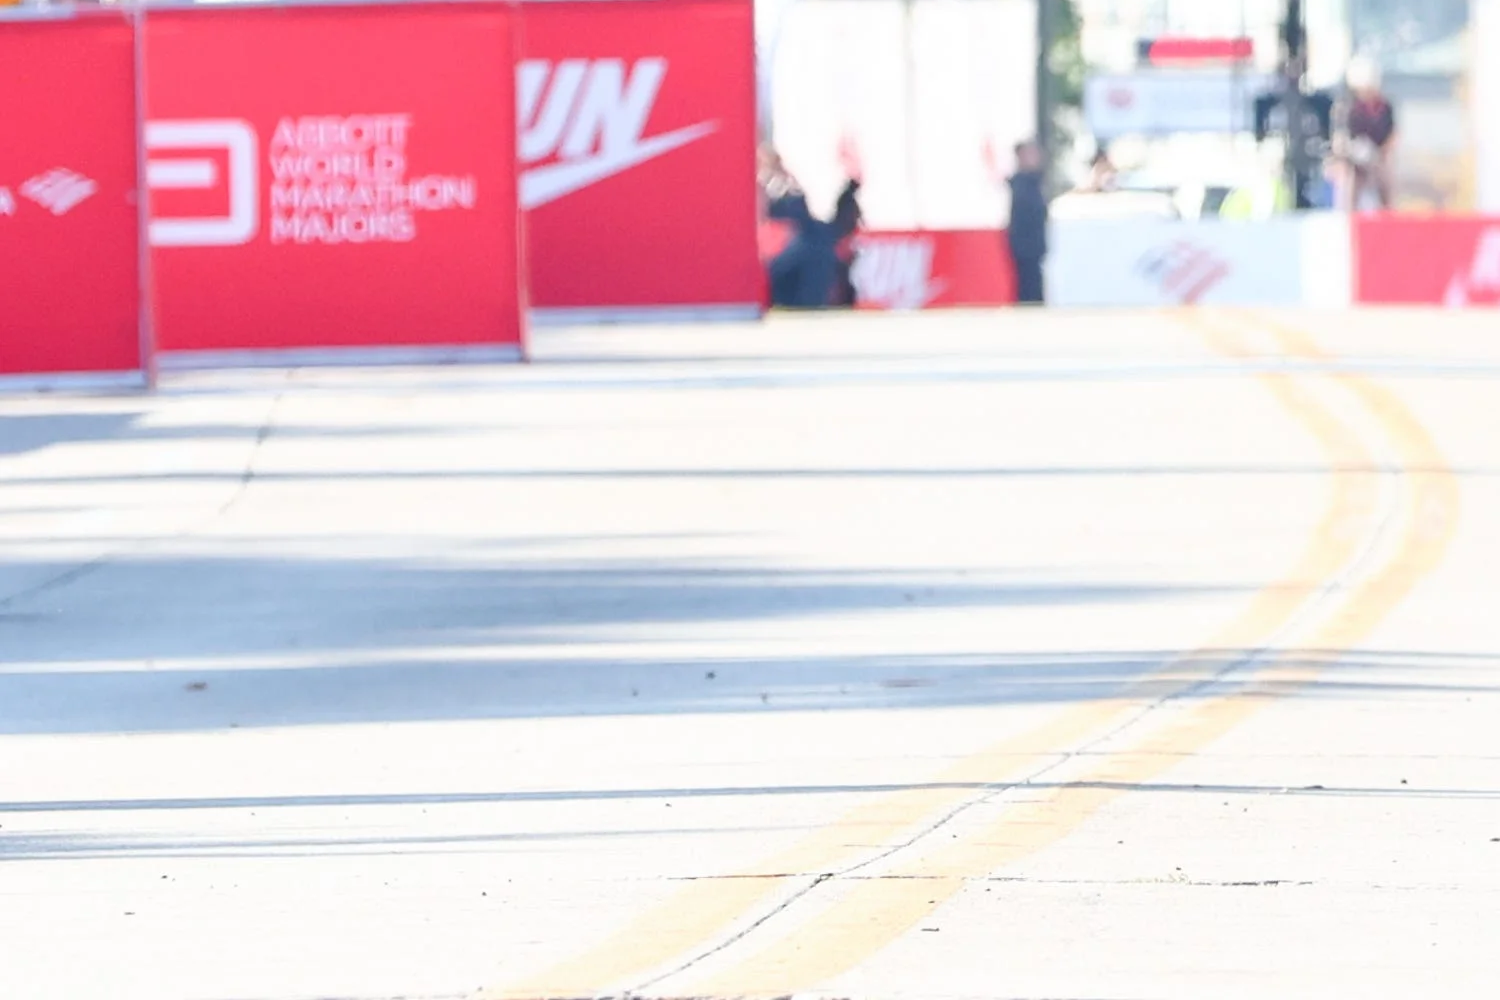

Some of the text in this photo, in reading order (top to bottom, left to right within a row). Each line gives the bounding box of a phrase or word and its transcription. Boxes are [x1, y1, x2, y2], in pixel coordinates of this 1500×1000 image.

[271, 114, 412, 149] ABBOTT
[270, 148, 406, 180] WORLD
[271, 174, 476, 210] MARATHON
[271, 208, 415, 244] MAJORS
